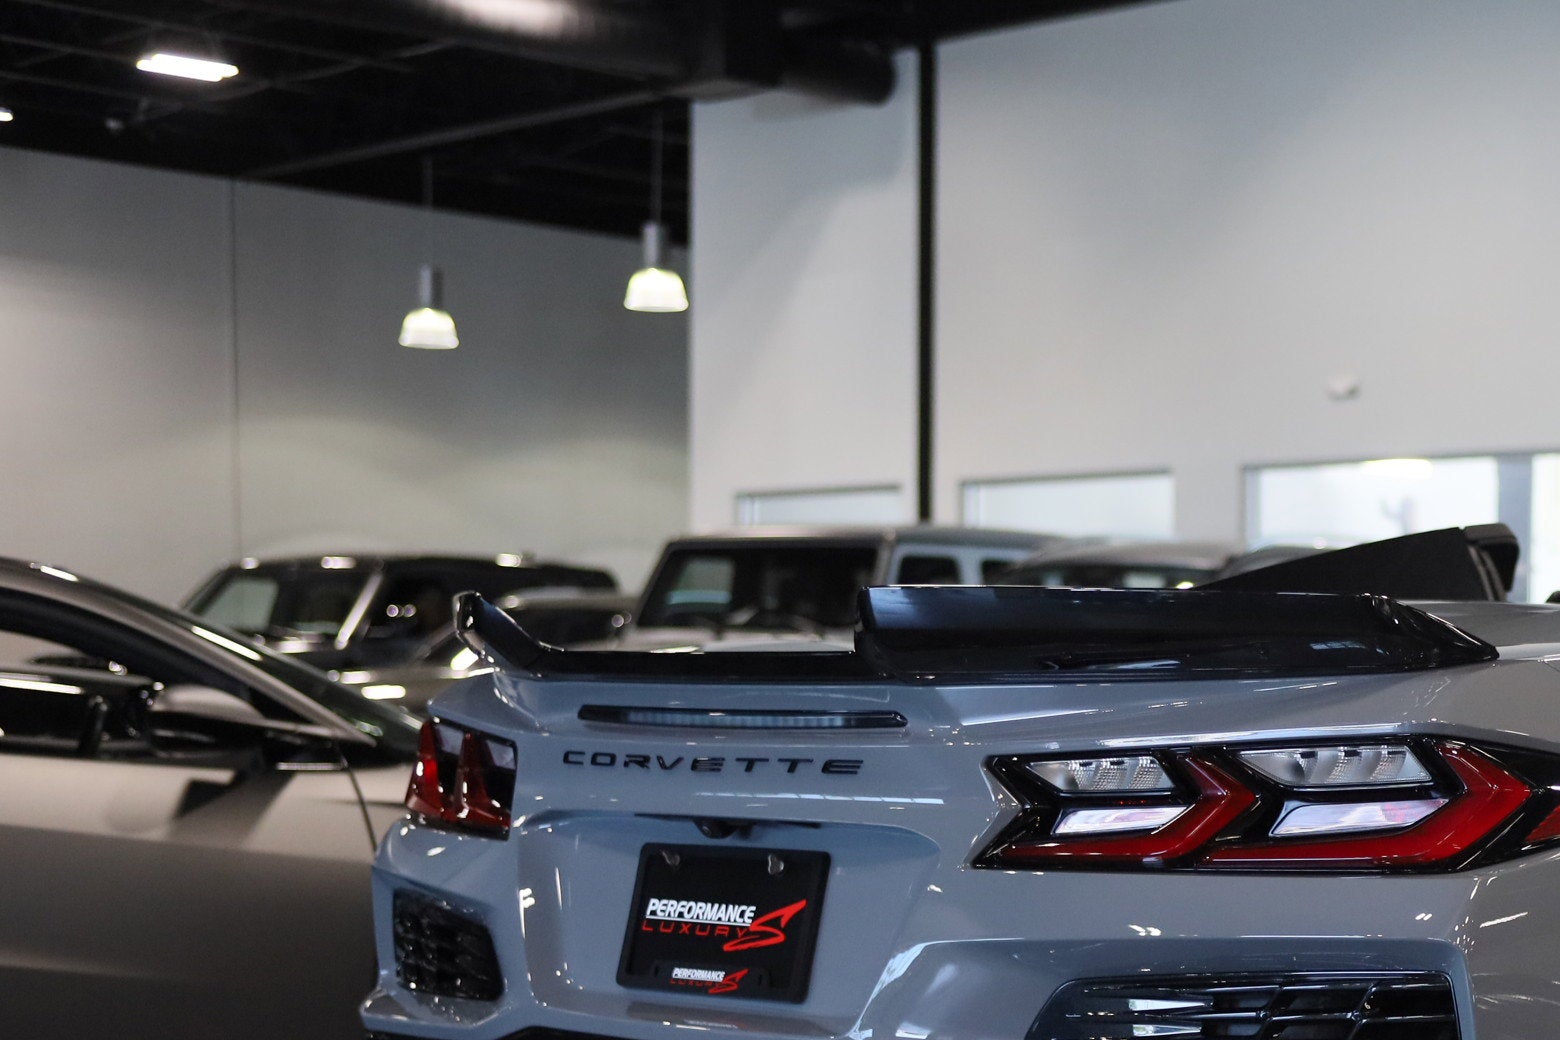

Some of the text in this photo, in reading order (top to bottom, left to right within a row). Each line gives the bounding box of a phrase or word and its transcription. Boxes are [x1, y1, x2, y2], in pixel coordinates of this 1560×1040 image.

[562, 750, 864, 775] CORVETTE
[646, 898, 757, 924] PERFORMANCE
[641, 919, 751, 939] LUXURY
[671, 966, 726, 983] PERFORMANCE
